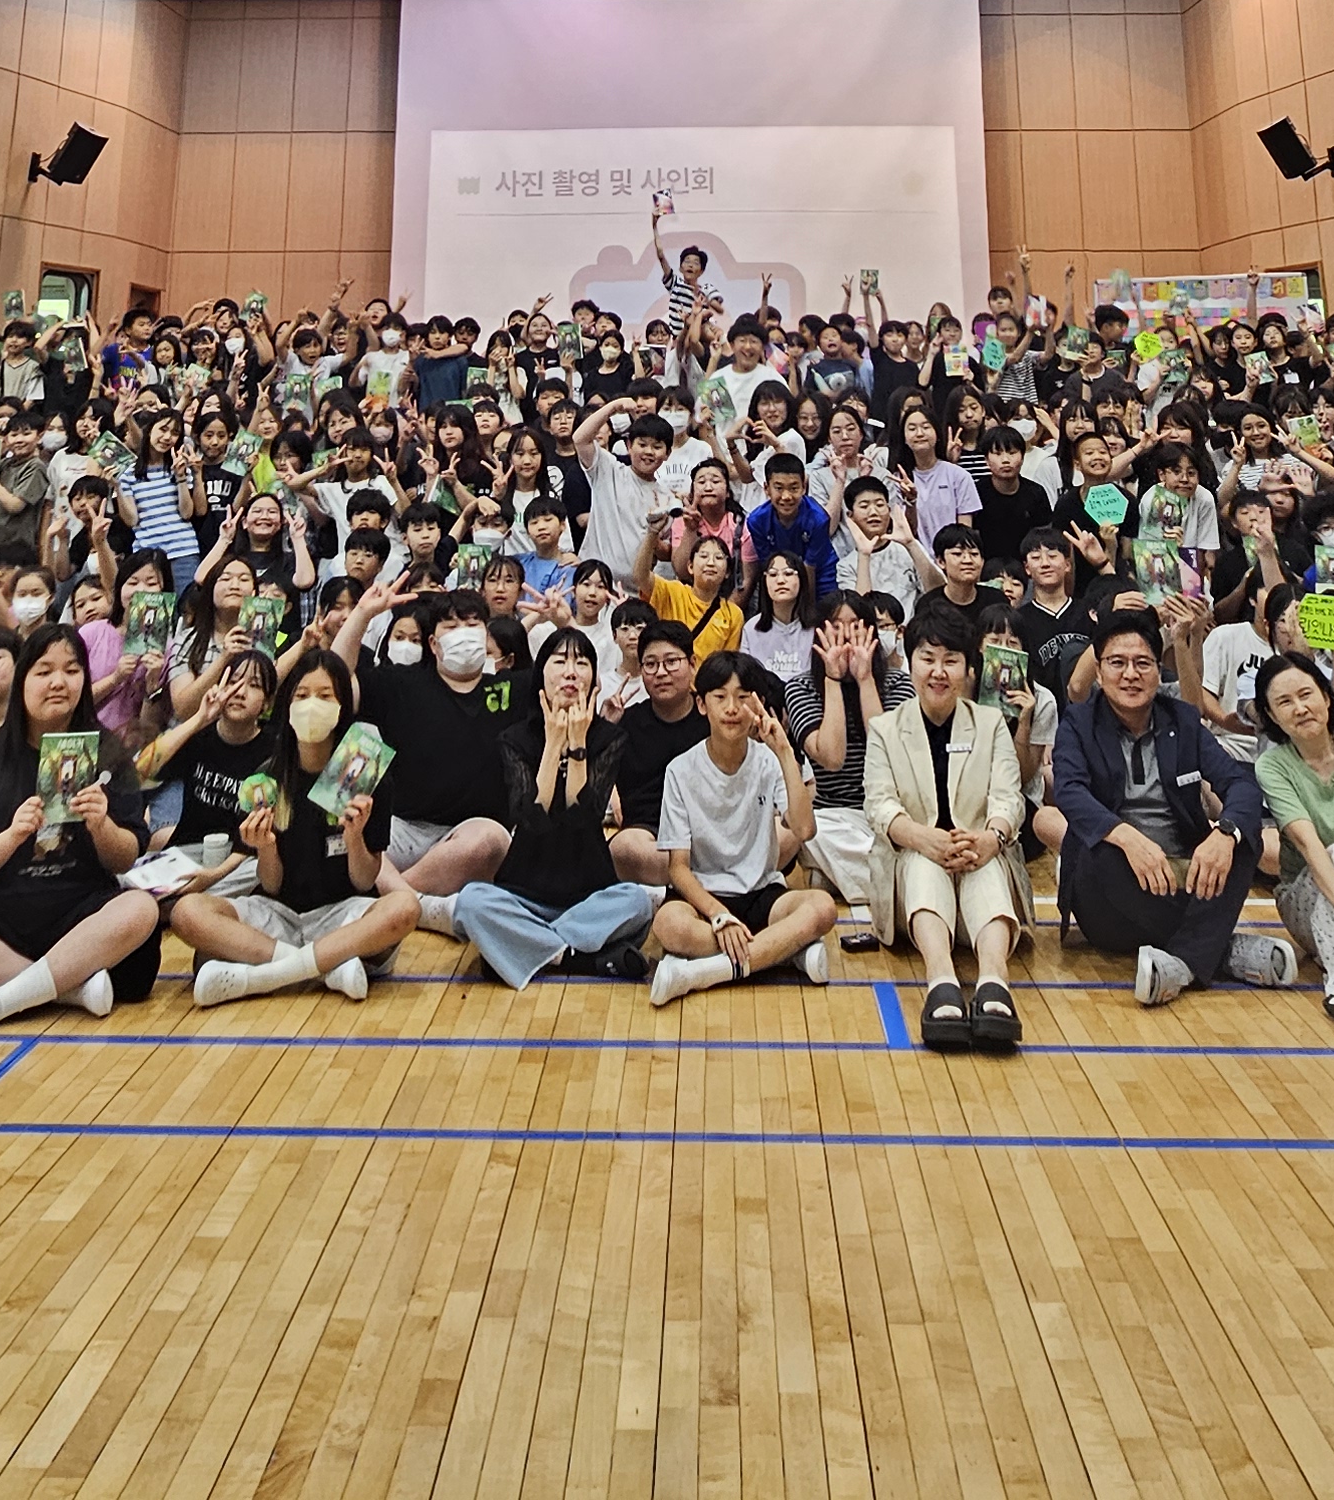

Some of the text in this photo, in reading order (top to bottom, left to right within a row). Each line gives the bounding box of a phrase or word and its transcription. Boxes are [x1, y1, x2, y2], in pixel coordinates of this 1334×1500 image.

[495, 166, 715, 198] 사진 촬영 및 사인회
